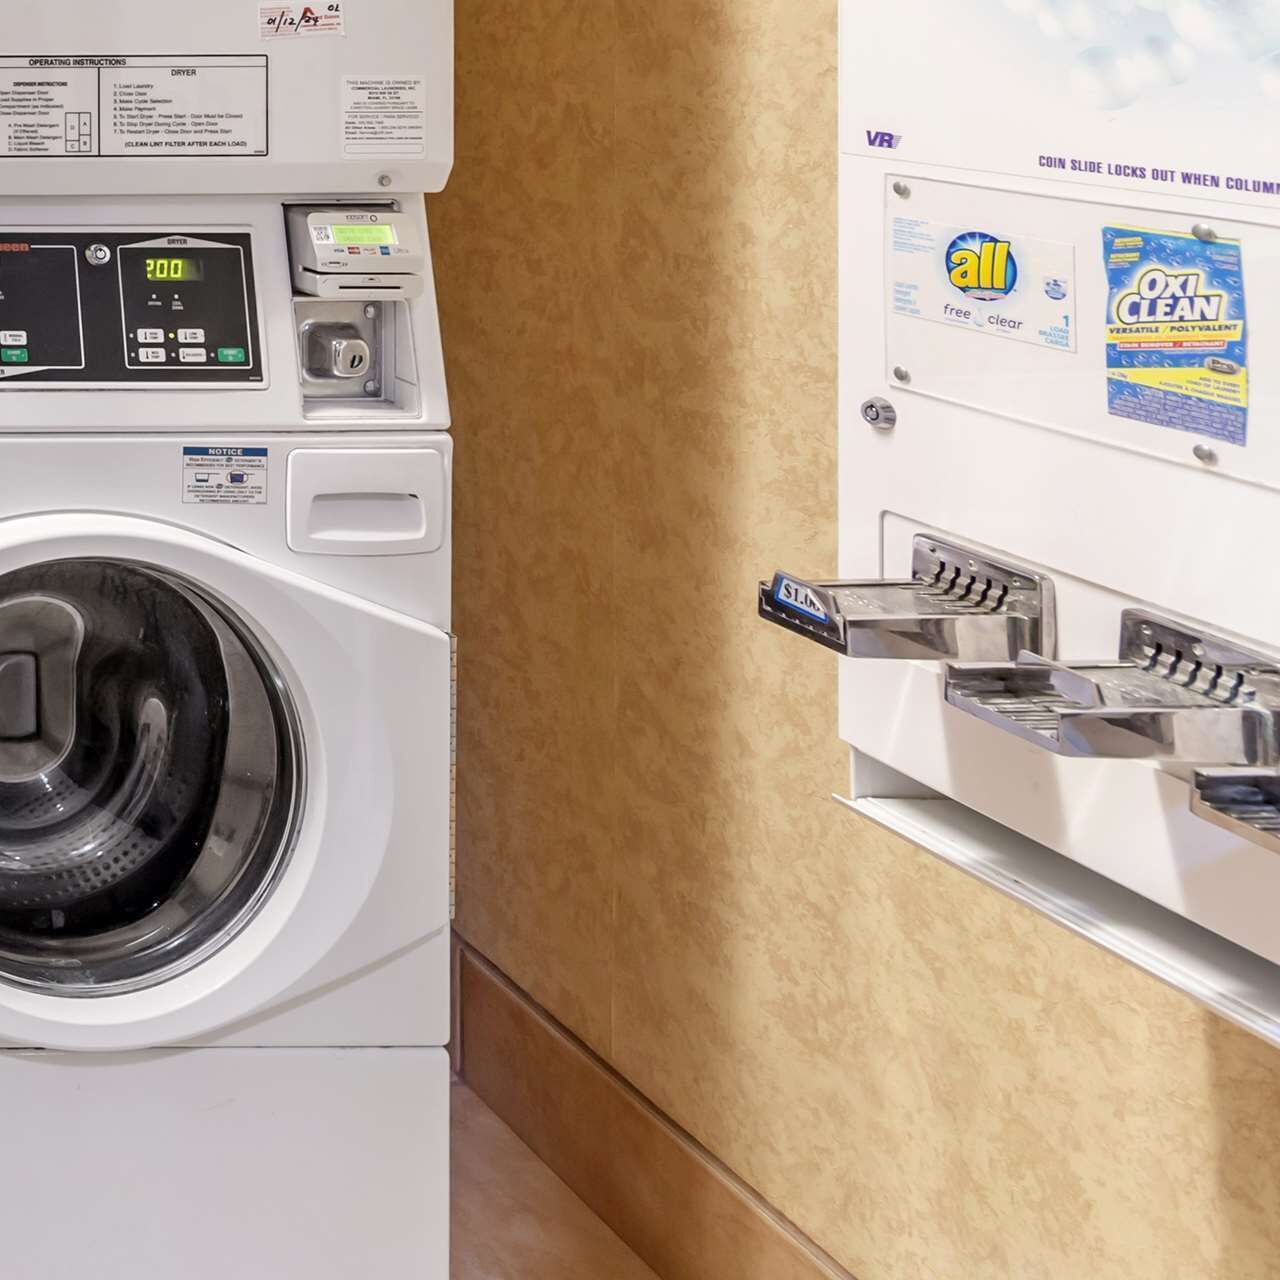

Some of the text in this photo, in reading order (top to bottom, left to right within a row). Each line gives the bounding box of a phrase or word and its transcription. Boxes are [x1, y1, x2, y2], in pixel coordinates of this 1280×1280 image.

[866, 130, 896, 149] VR
[1038, 155, 1066, 170] COIN
[1070, 159, 1103, 174] SLIDE
[1107, 163, 1147, 179] LOCKS
[1151, 168, 1176, 183] OUT
[1181, 172, 1220, 188] WHEN
[949, 241, 1011, 290] all
[1139, 269, 1200, 299] OXI
[943, 303, 1024, 330] free clear
[1062, 315, 1069, 327] 1
[1117, 293, 1223, 325] CLEAN
[1109, 326, 1160, 335] VERSATILE
[1170, 324, 1238, 333] POLYVALENT
[208, 448, 243, 456] NOTICE
